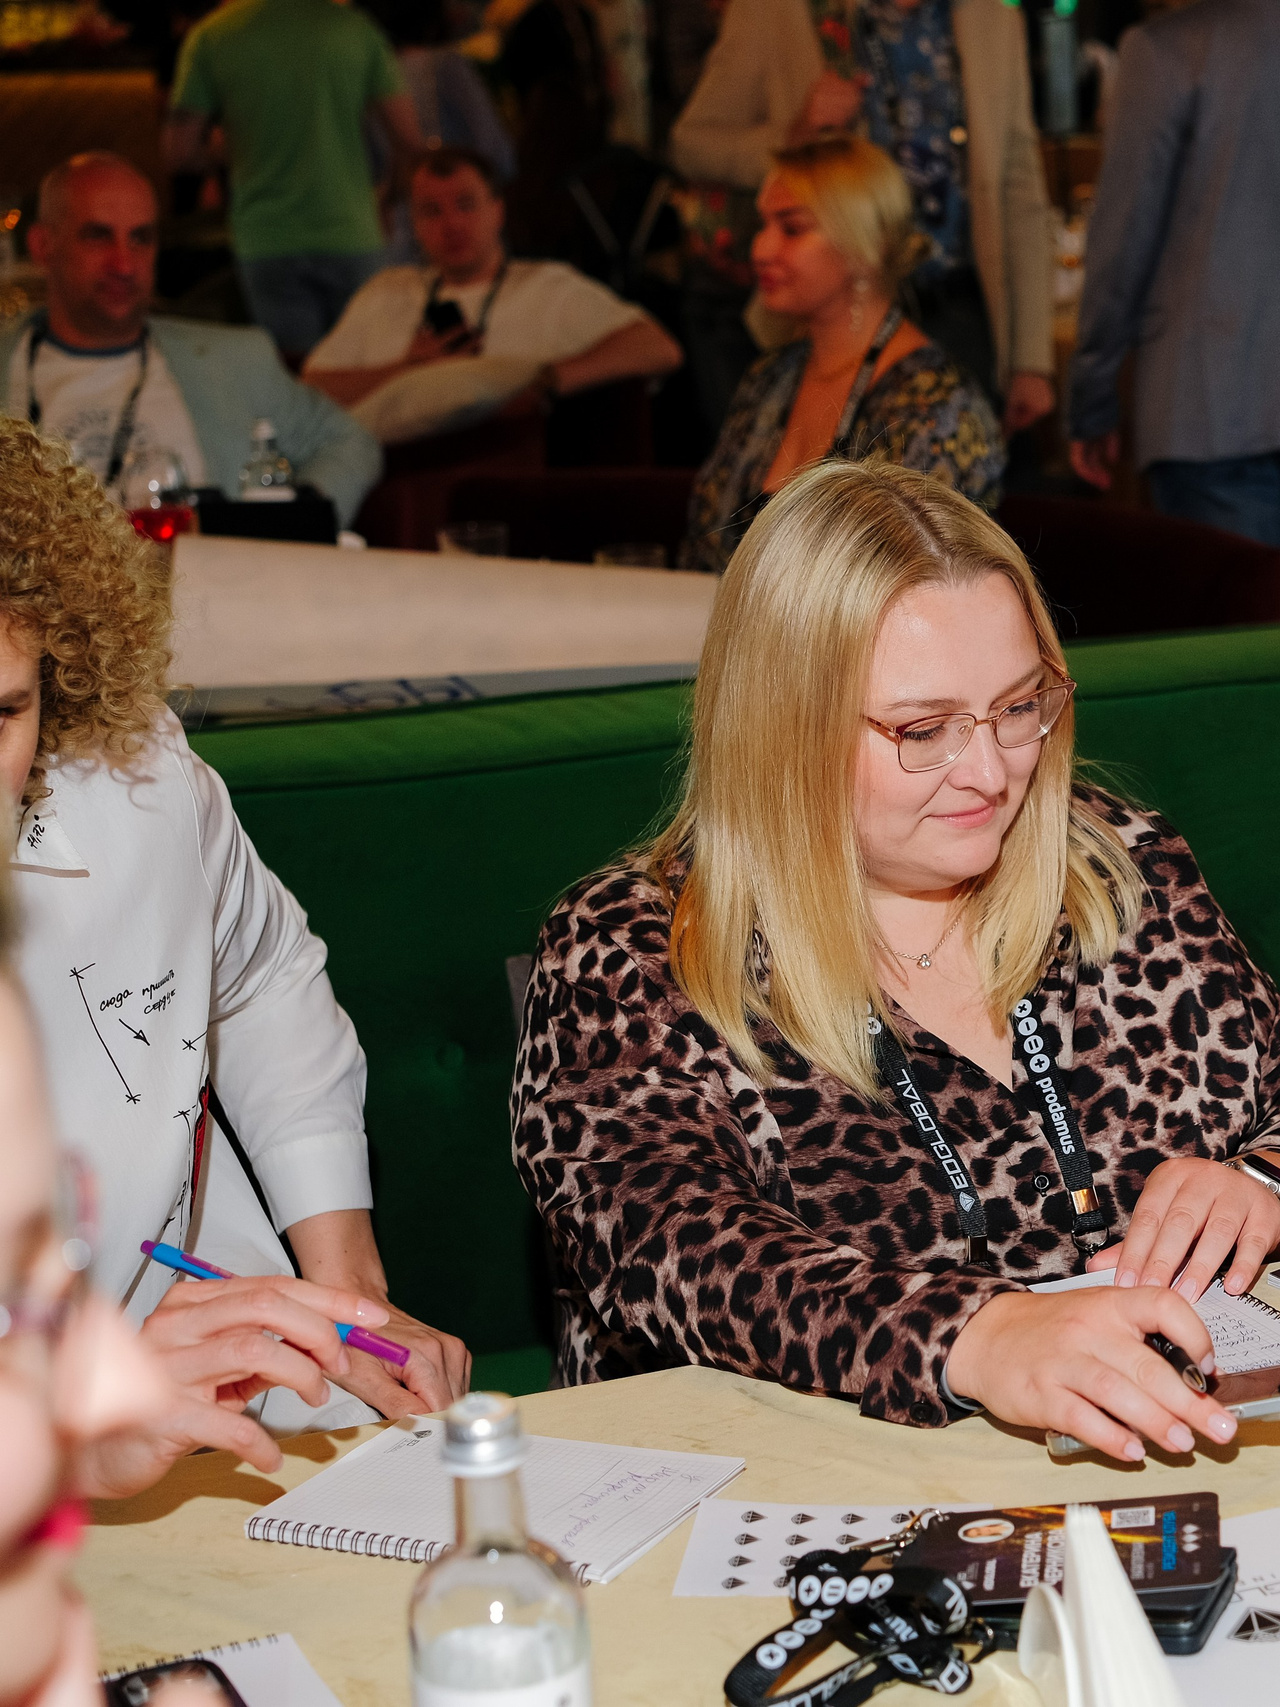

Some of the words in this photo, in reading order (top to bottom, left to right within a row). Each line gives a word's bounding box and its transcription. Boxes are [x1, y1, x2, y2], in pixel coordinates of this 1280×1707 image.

[100, 989, 134, 1011] сюда
[896, 1069, 969, 1190] EDGLOBAL
[1035, 1076, 1076, 1155] prodamus
